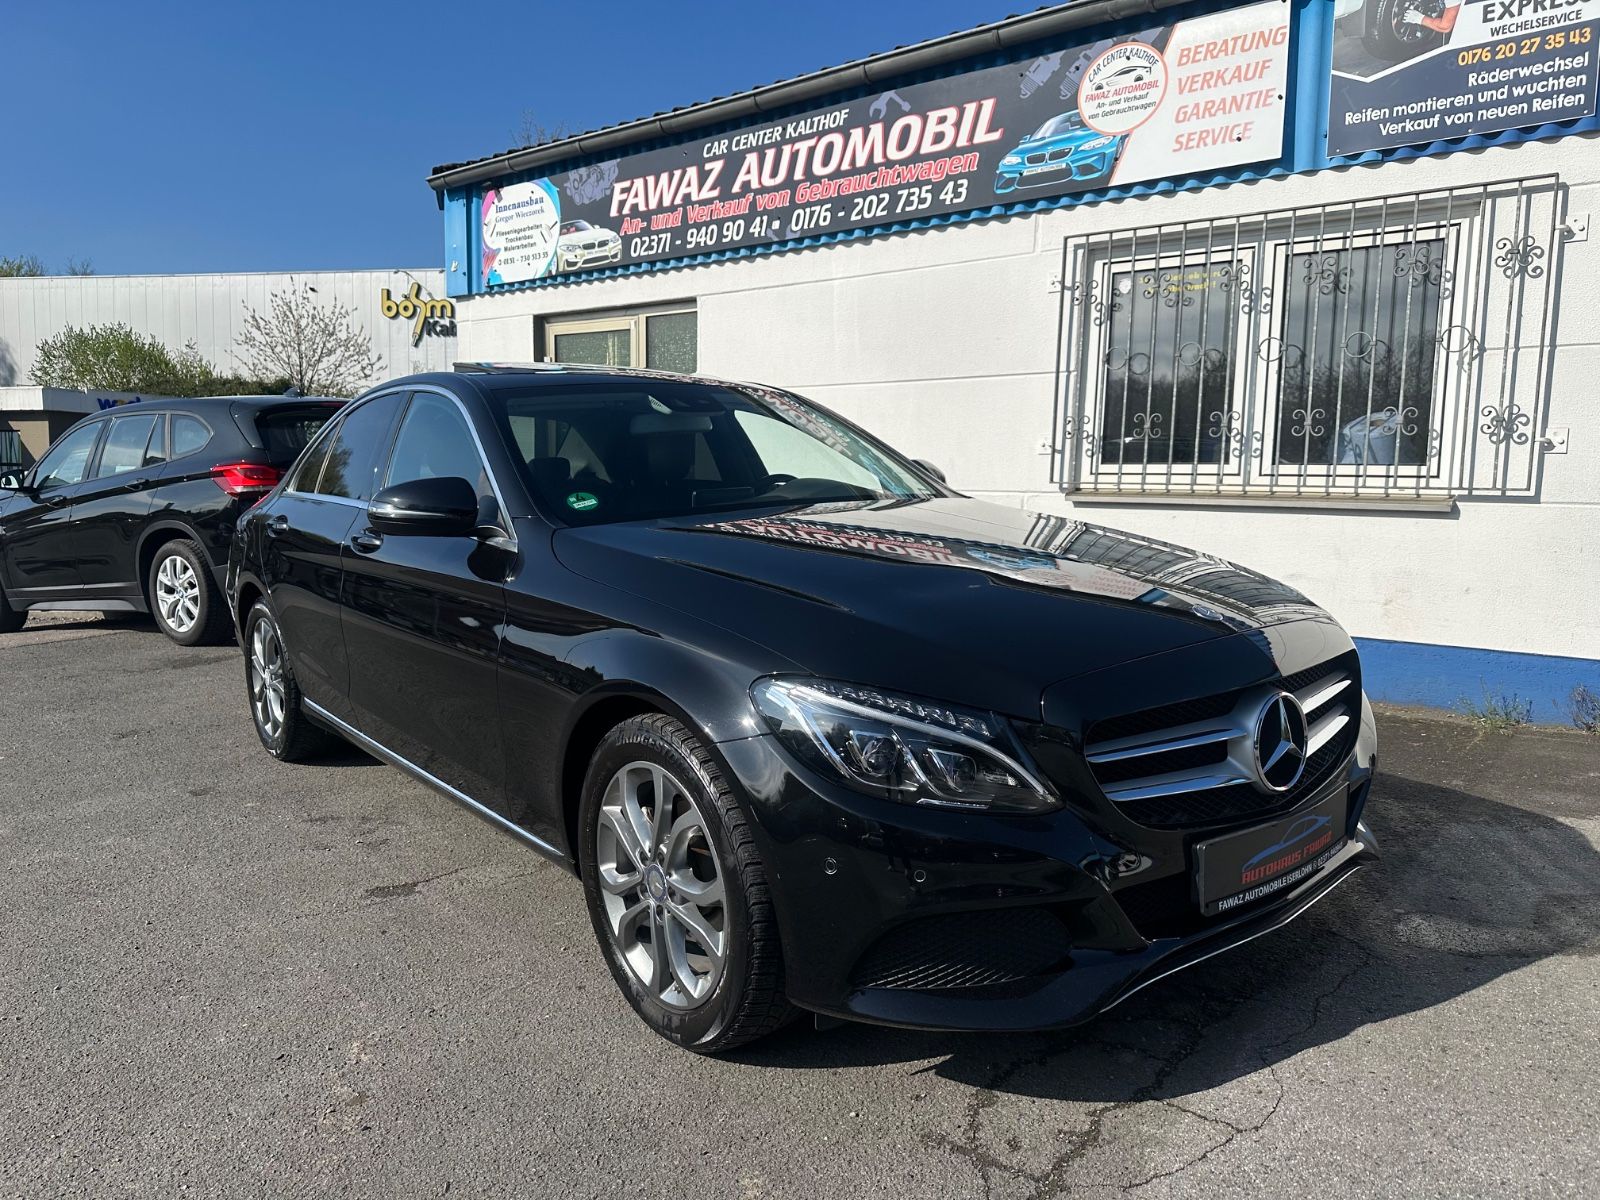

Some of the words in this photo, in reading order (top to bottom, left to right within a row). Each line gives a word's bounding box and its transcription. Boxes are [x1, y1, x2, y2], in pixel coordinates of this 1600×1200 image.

[1482, 0, 1588, 23] EXPR
[1490, 9, 1582, 37] WECHELSERVICE
[1177, 25, 1287, 67] BERATUNG
[1458, 46, 1491, 66] 0176
[1495, 42, 1516, 60] 20
[1520, 37, 1541, 55] 27
[1544, 32, 1565, 50] 35
[1569, 27, 1592, 45] 43
[1088, 64, 1102, 83] CAR
[1102, 48, 1128, 67] CENTER
[1129, 47, 1159, 66] KALTHOF
[1178, 59, 1273, 95] VERKAUF
[1468, 51, 1590, 87] Räderwechsel
[1085, 90, 1111, 103] FAWAZ
[1112, 80, 1159, 98] AUTOMOBIL
[1101, 101, 1156, 118] Gebrauchtwagen
[1109, 98, 1122, 107] und
[1123, 92, 1149, 103] Verkauf
[1175, 88, 1277, 124] GARANTIE
[1345, 107, 1389, 125] Reifen
[1393, 93, 1474, 118] montieren
[1477, 84, 1508, 102] und
[1512, 73, 1587, 97] wuchten
[1379, 115, 1440, 136] Verkauf
[1444, 110, 1474, 125] von
[1477, 101, 1529, 122] neuen
[1532, 92, 1586, 113] Reifen
[703, 140, 728, 158] CAR
[731, 126, 782, 152] CENTER
[786, 109, 850, 139] KALTHOF
[1172, 121, 1255, 153] SERVICE
[609, 159, 725, 217] FAWAZ
[731, 97, 1004, 194] AUTOMOBIL
[495, 196, 544, 213] Innenausbau
[620, 216, 647, 236] An-
[651, 206, 683, 231] und
[687, 192, 753, 223] Verkauf
[756, 189, 790, 211] von
[796, 152, 979, 205] Gebrauchtwagen
[630, 232, 671, 258] 02371
[687, 224, 718, 249] 940
[722, 220, 745, 243] 90
[750, 215, 768, 238] 41
[791, 203, 832, 231] 0176
[851, 192, 890, 221] 202
[895, 185, 932, 213] 735
[939, 179, 968, 205] 43
[1242, 850, 1302, 885] AUTOHAUS
[1218, 894, 1244, 911] FAWAZ
[1244, 876, 1287, 902] AUTOMOBILE
[1287, 864, 1312, 884] ISERLOHN
